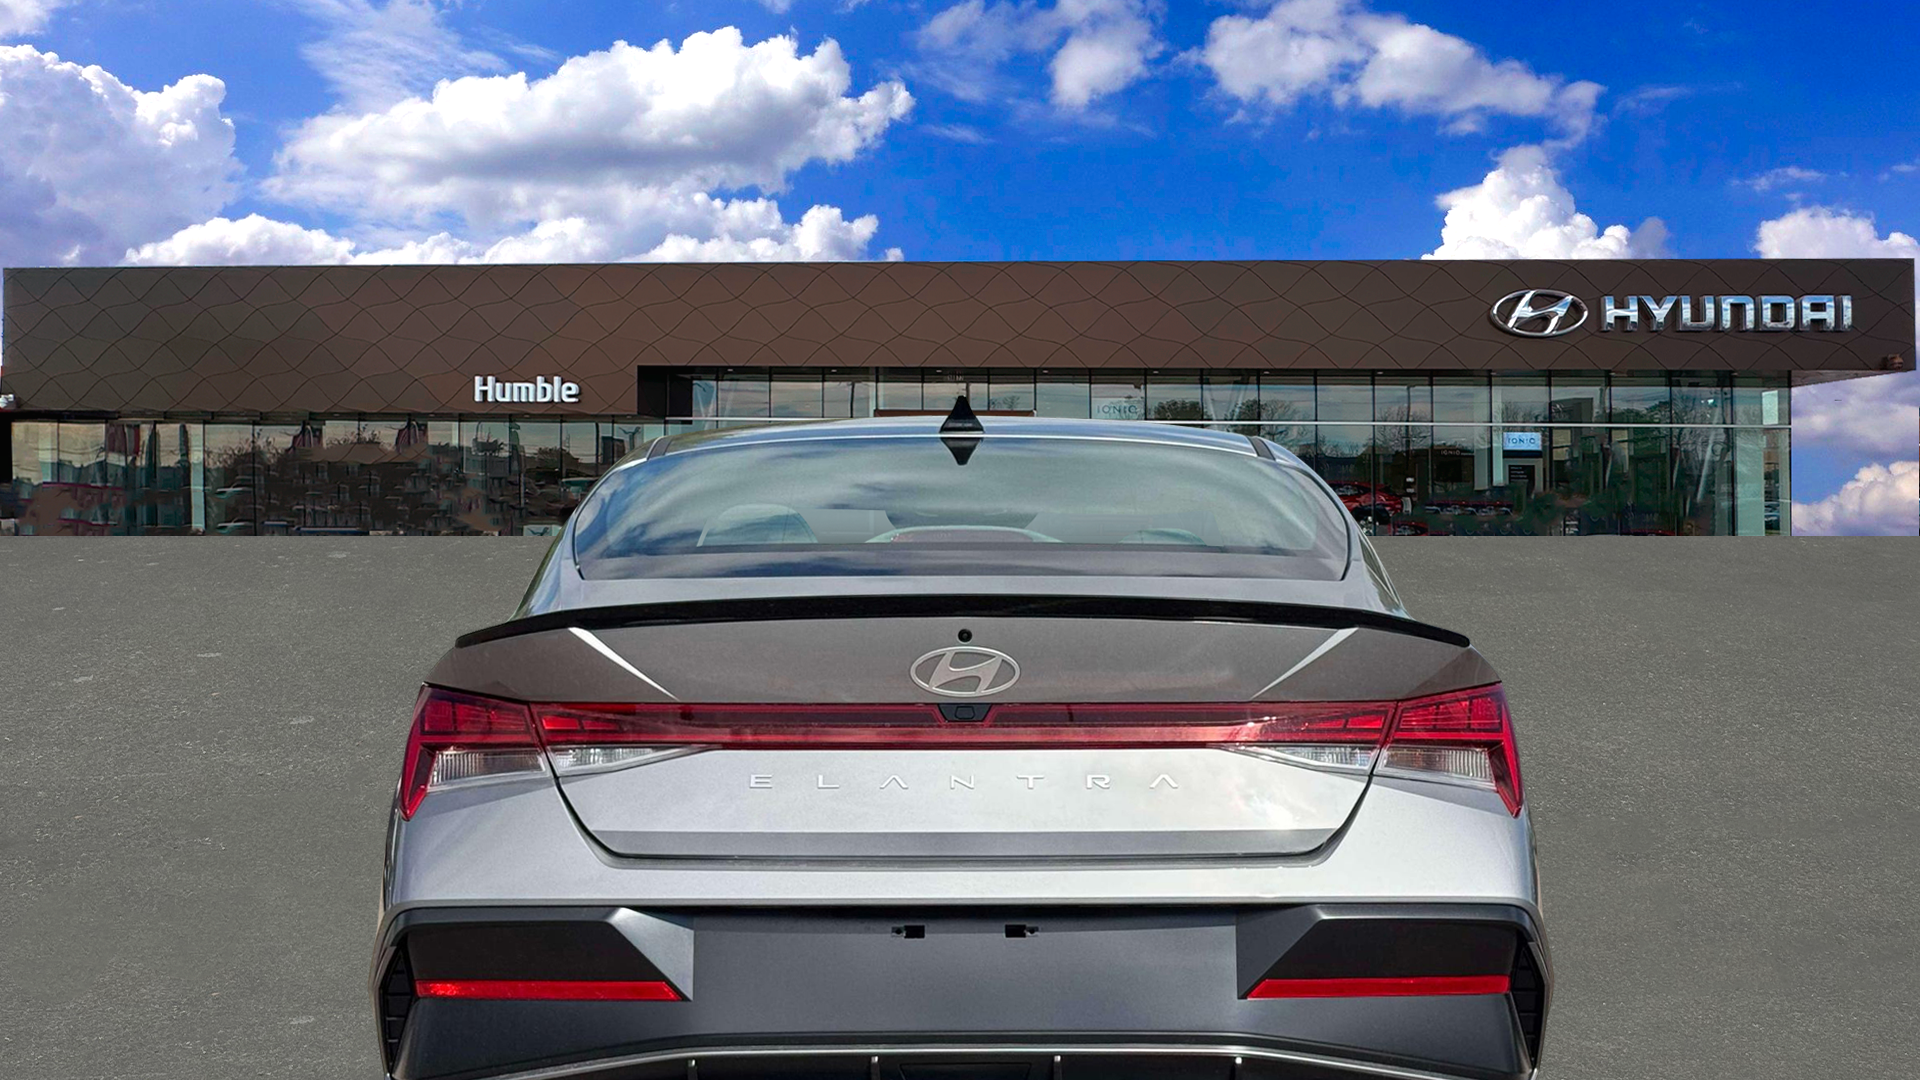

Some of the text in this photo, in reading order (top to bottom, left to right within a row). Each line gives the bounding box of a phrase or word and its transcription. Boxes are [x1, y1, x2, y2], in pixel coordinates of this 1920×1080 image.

[1602, 295, 1852, 331] HYUNDAI
[474, 375, 580, 402] Humble
[748, 773, 1179, 789] ELANTRA
